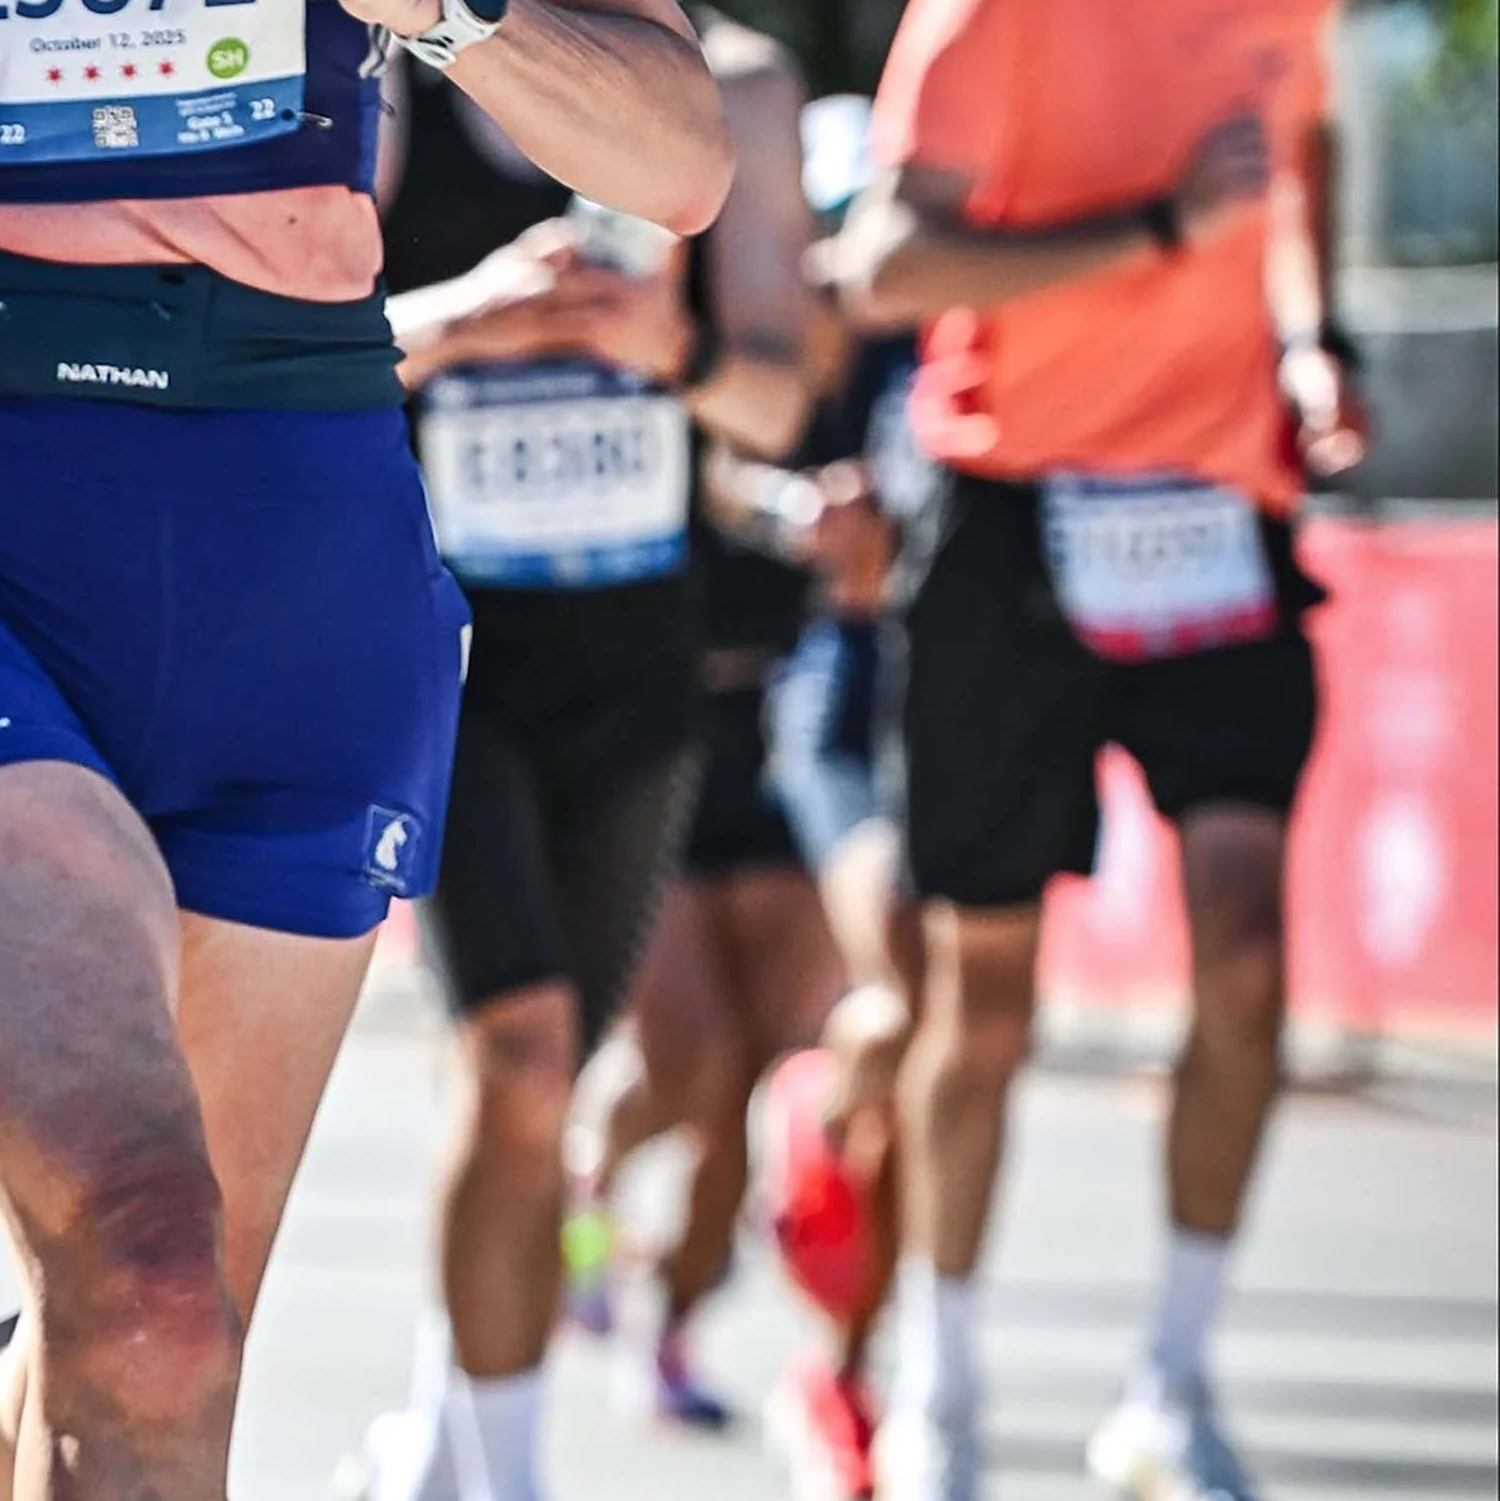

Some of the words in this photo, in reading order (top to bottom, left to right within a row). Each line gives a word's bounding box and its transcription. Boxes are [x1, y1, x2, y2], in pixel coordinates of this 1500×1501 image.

[30, 37, 100, 53] October
[141, 29, 187, 46] 2025
[250, 98, 276, 120] 22
[0, 124, 26, 145] 22
[57, 362, 169, 389] NATHAN
